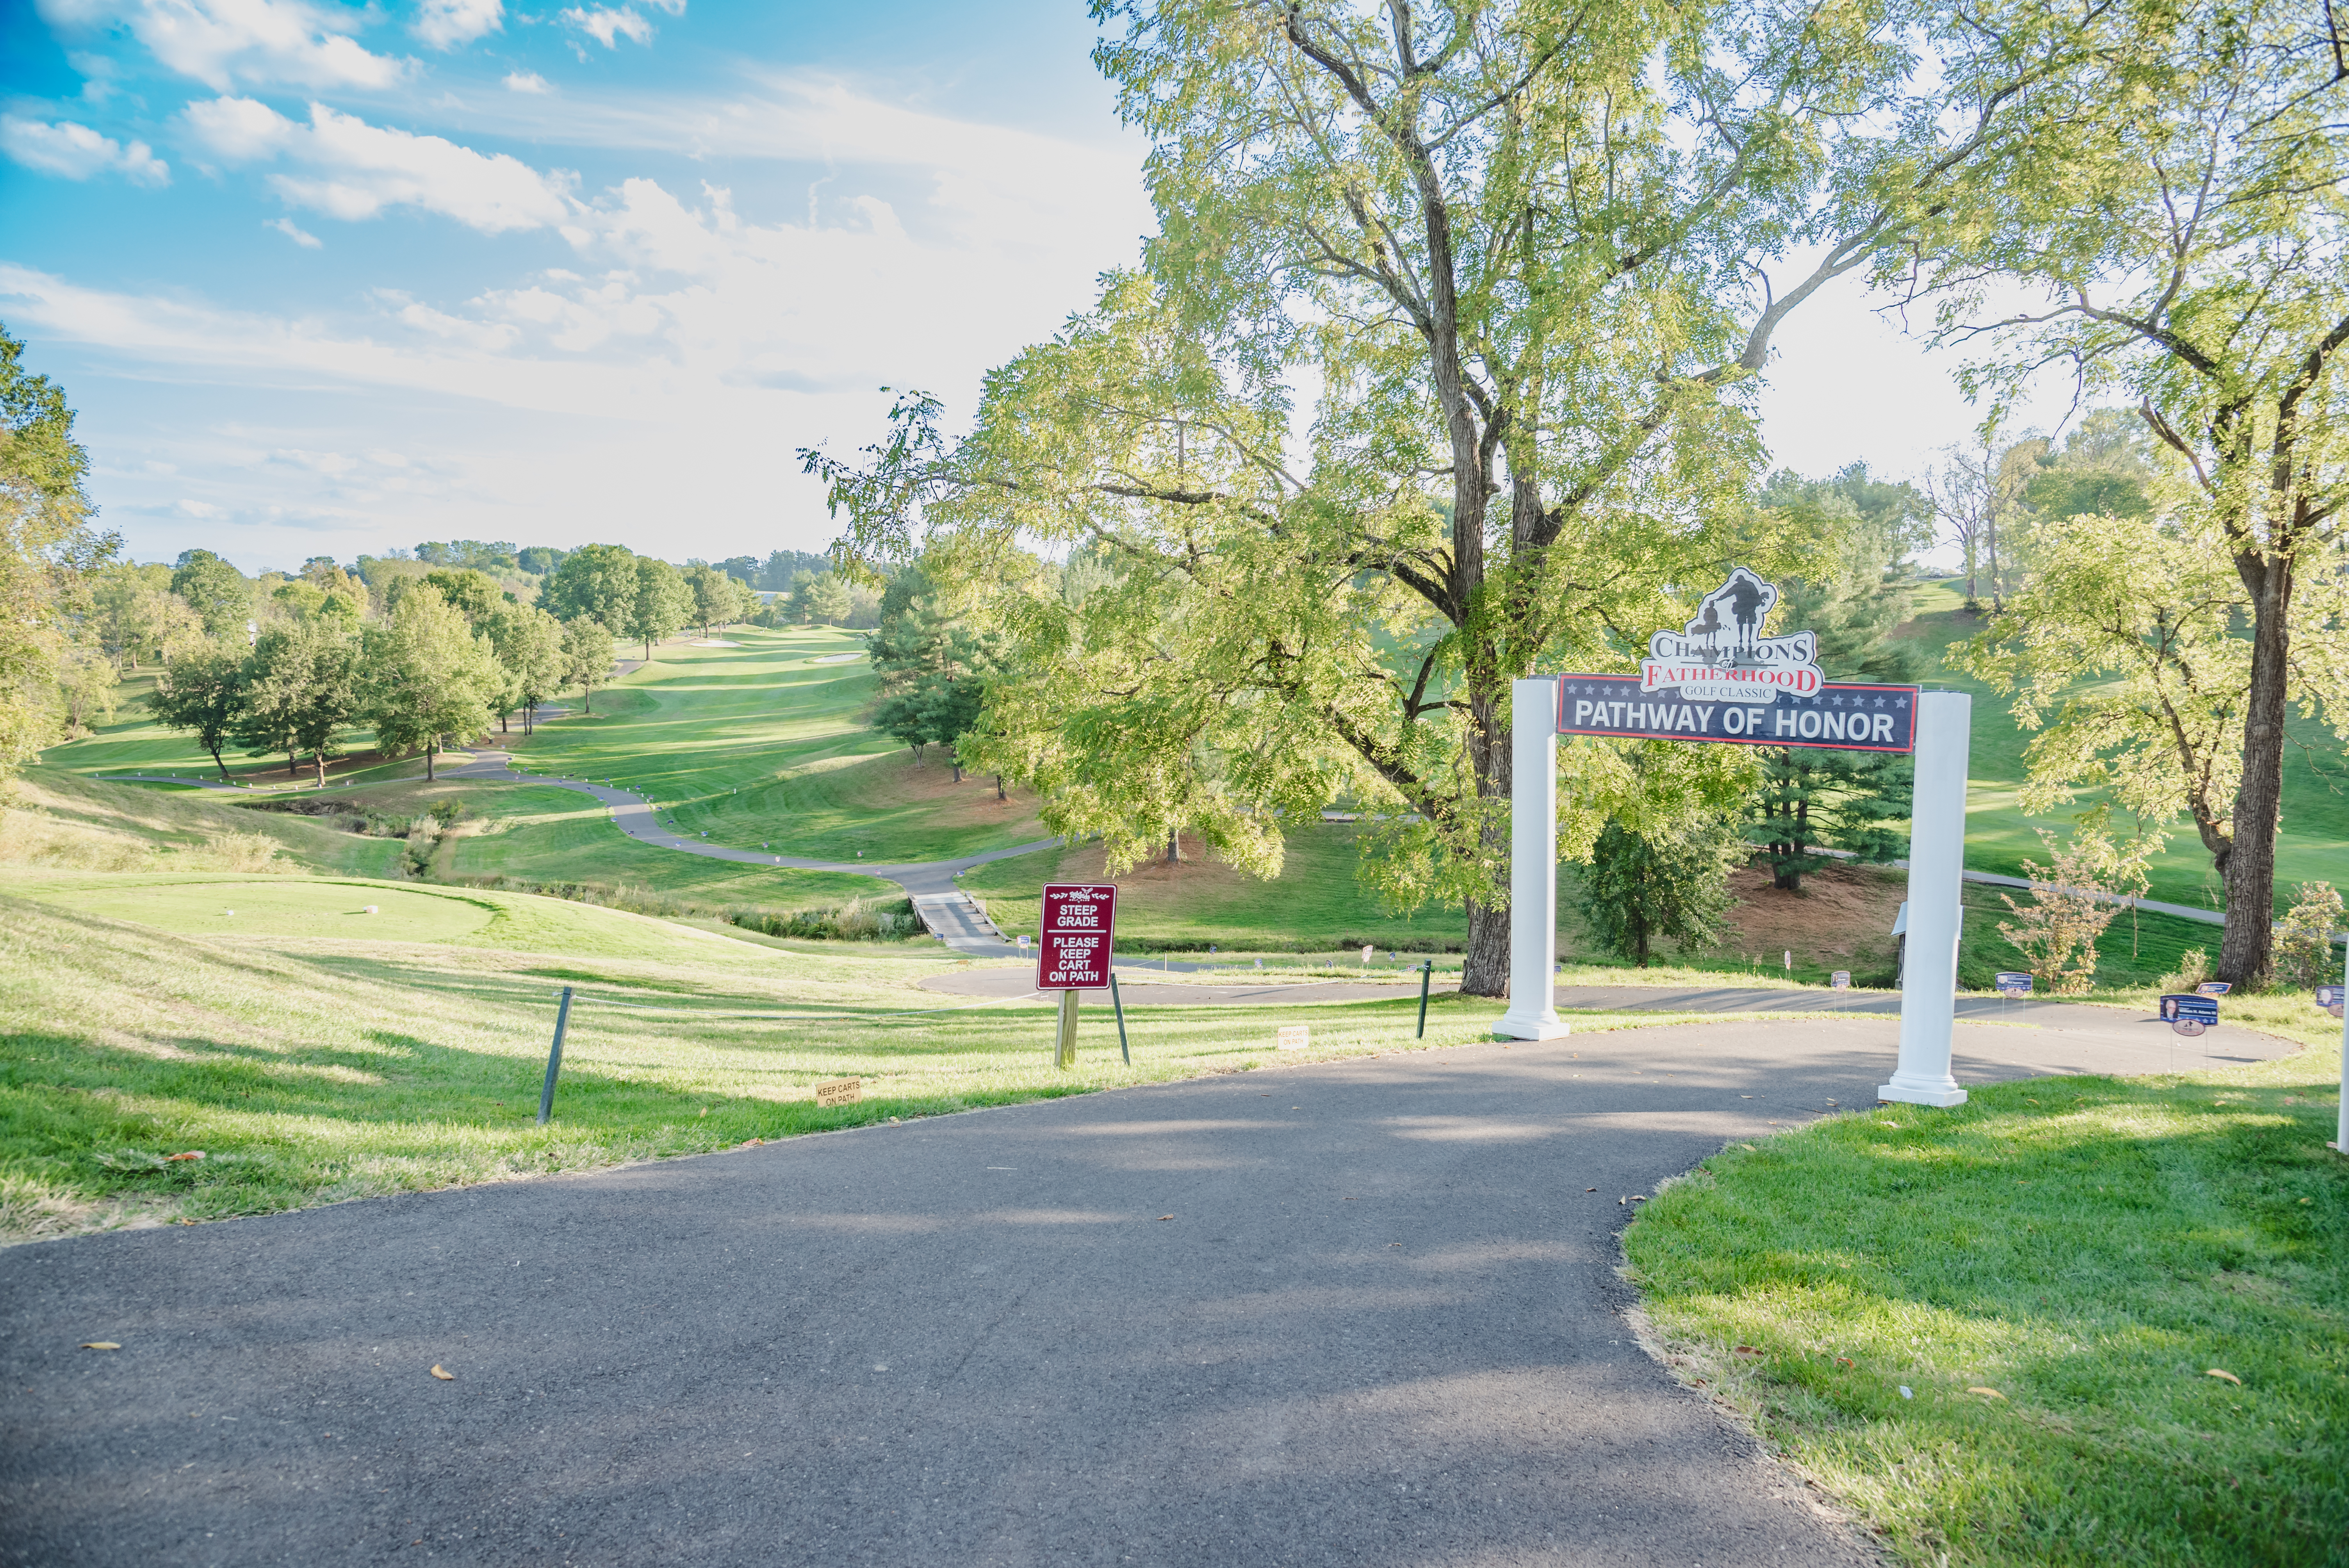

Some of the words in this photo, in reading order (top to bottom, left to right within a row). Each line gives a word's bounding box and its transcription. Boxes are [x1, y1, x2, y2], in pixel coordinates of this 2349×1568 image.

[1655, 637, 1808, 661] CHAMPIONS
[1721, 656, 1734, 672] of
[1645, 665, 1816, 692] FATHERHOOD
[1685, 686, 1716, 696] GOLF
[1720, 687, 1771, 698] CLASSIC
[1575, 700, 1715, 732] PATHWAY
[1723, 707, 1765, 735] OF
[1775, 709, 1895, 742] HONOR
[1060, 905, 1098, 915] STEEP
[1057, 916, 1098, 927] GRADE
[1053, 937, 1099, 948] PLEASE
[1060, 949, 1091, 959] KEEP
[1059, 960, 1091, 970] CART
[1049, 971, 1067, 982] ON
[1069, 971, 1099, 981] PATH
[818, 1086, 836, 1097] KEEP
[838, 1081, 860, 1092] CARTS
[826, 1097, 836, 1106] ON
[838, 1093, 855, 1103] PATH
